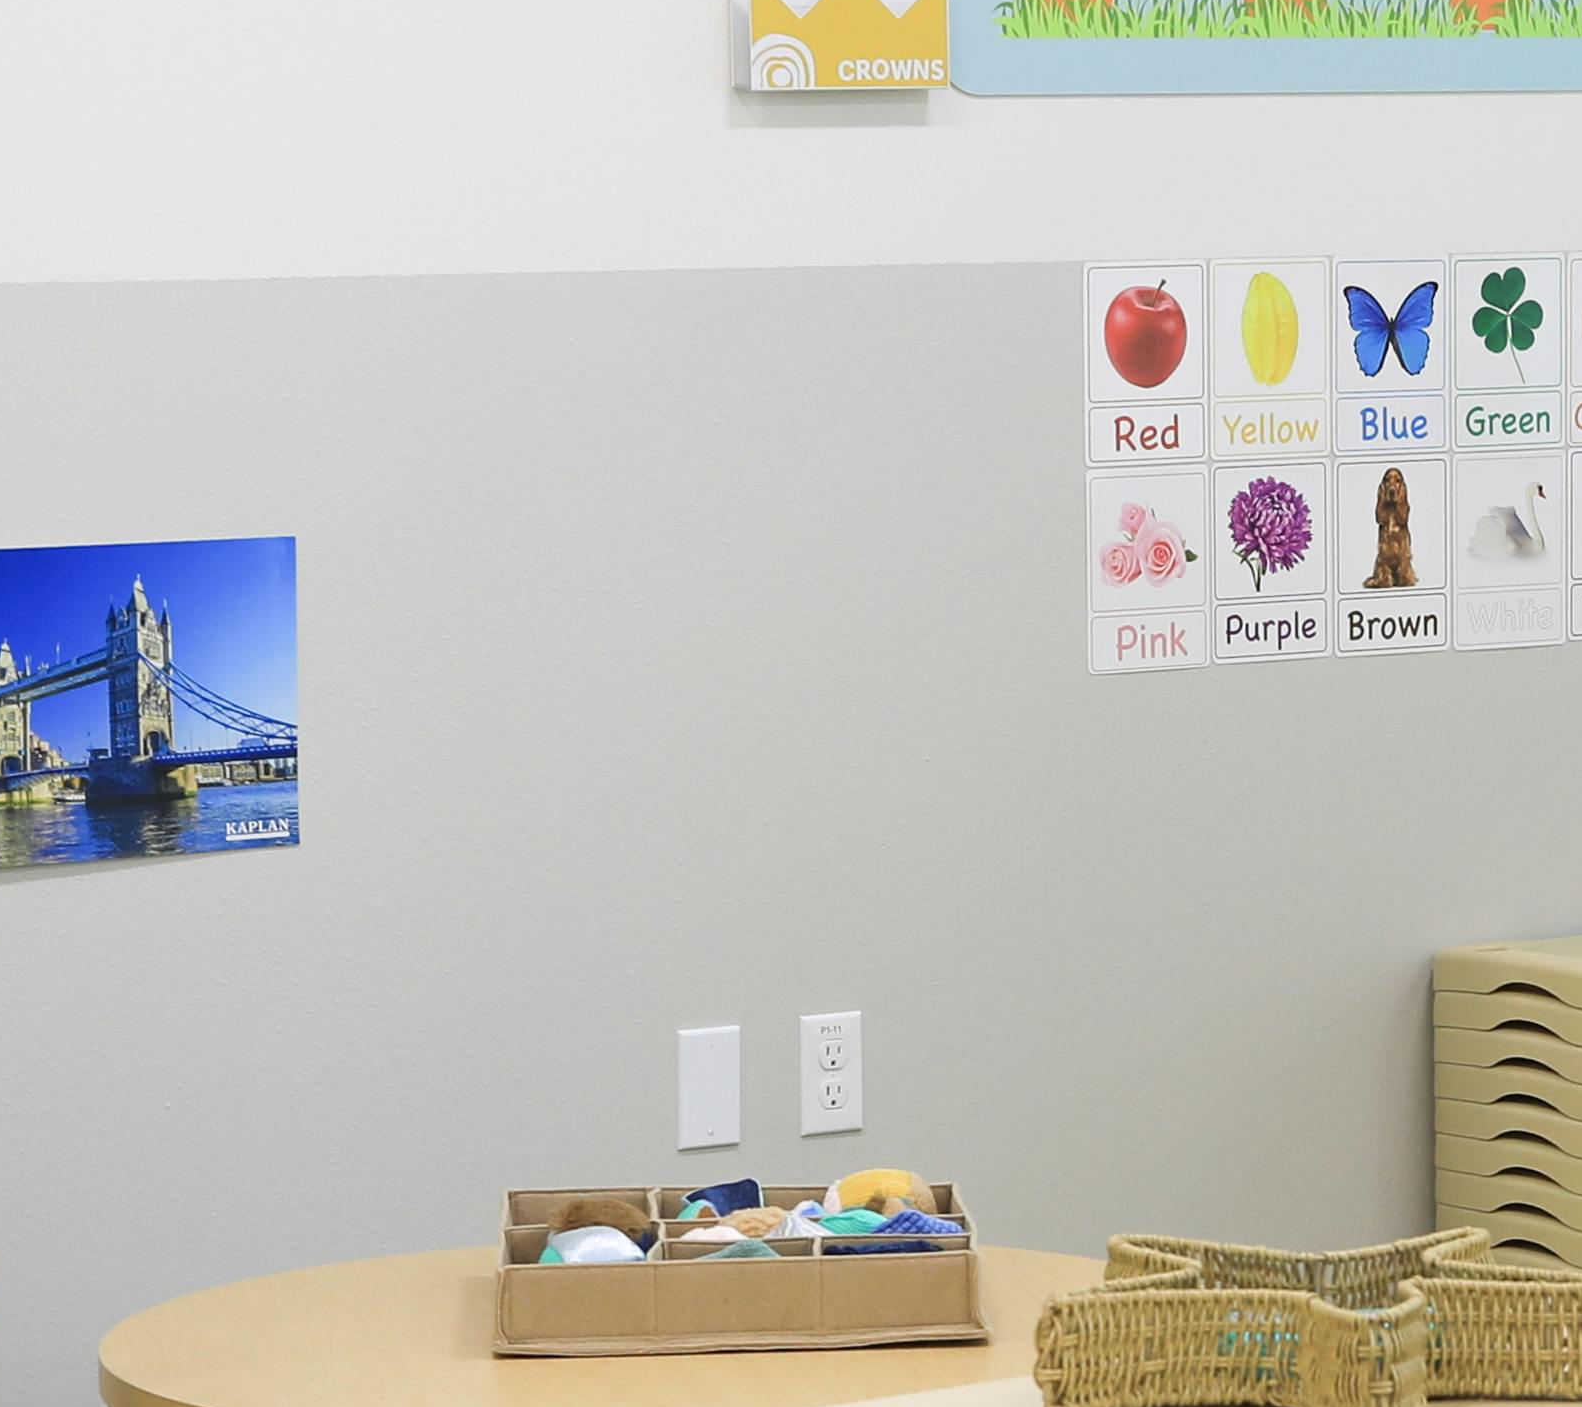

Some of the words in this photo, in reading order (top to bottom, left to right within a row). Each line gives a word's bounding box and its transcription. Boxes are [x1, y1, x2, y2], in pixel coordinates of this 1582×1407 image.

[837, 58, 945, 82] CROWNS
[1114, 414, 1180, 451] Red
[1222, 413, 1319, 447] Yellow
[1360, 406, 1429, 440] Blue
[1465, 405, 1551, 437] Green
[1225, 611, 1317, 650] Purple
[1347, 610, 1438, 641] Brown
[1466, 598, 1555, 634] White
[1116, 622, 1188, 661] Pink
[225, 818, 289, 835] KAPLAN
[820, 1025, 842, 1034] P1-11
